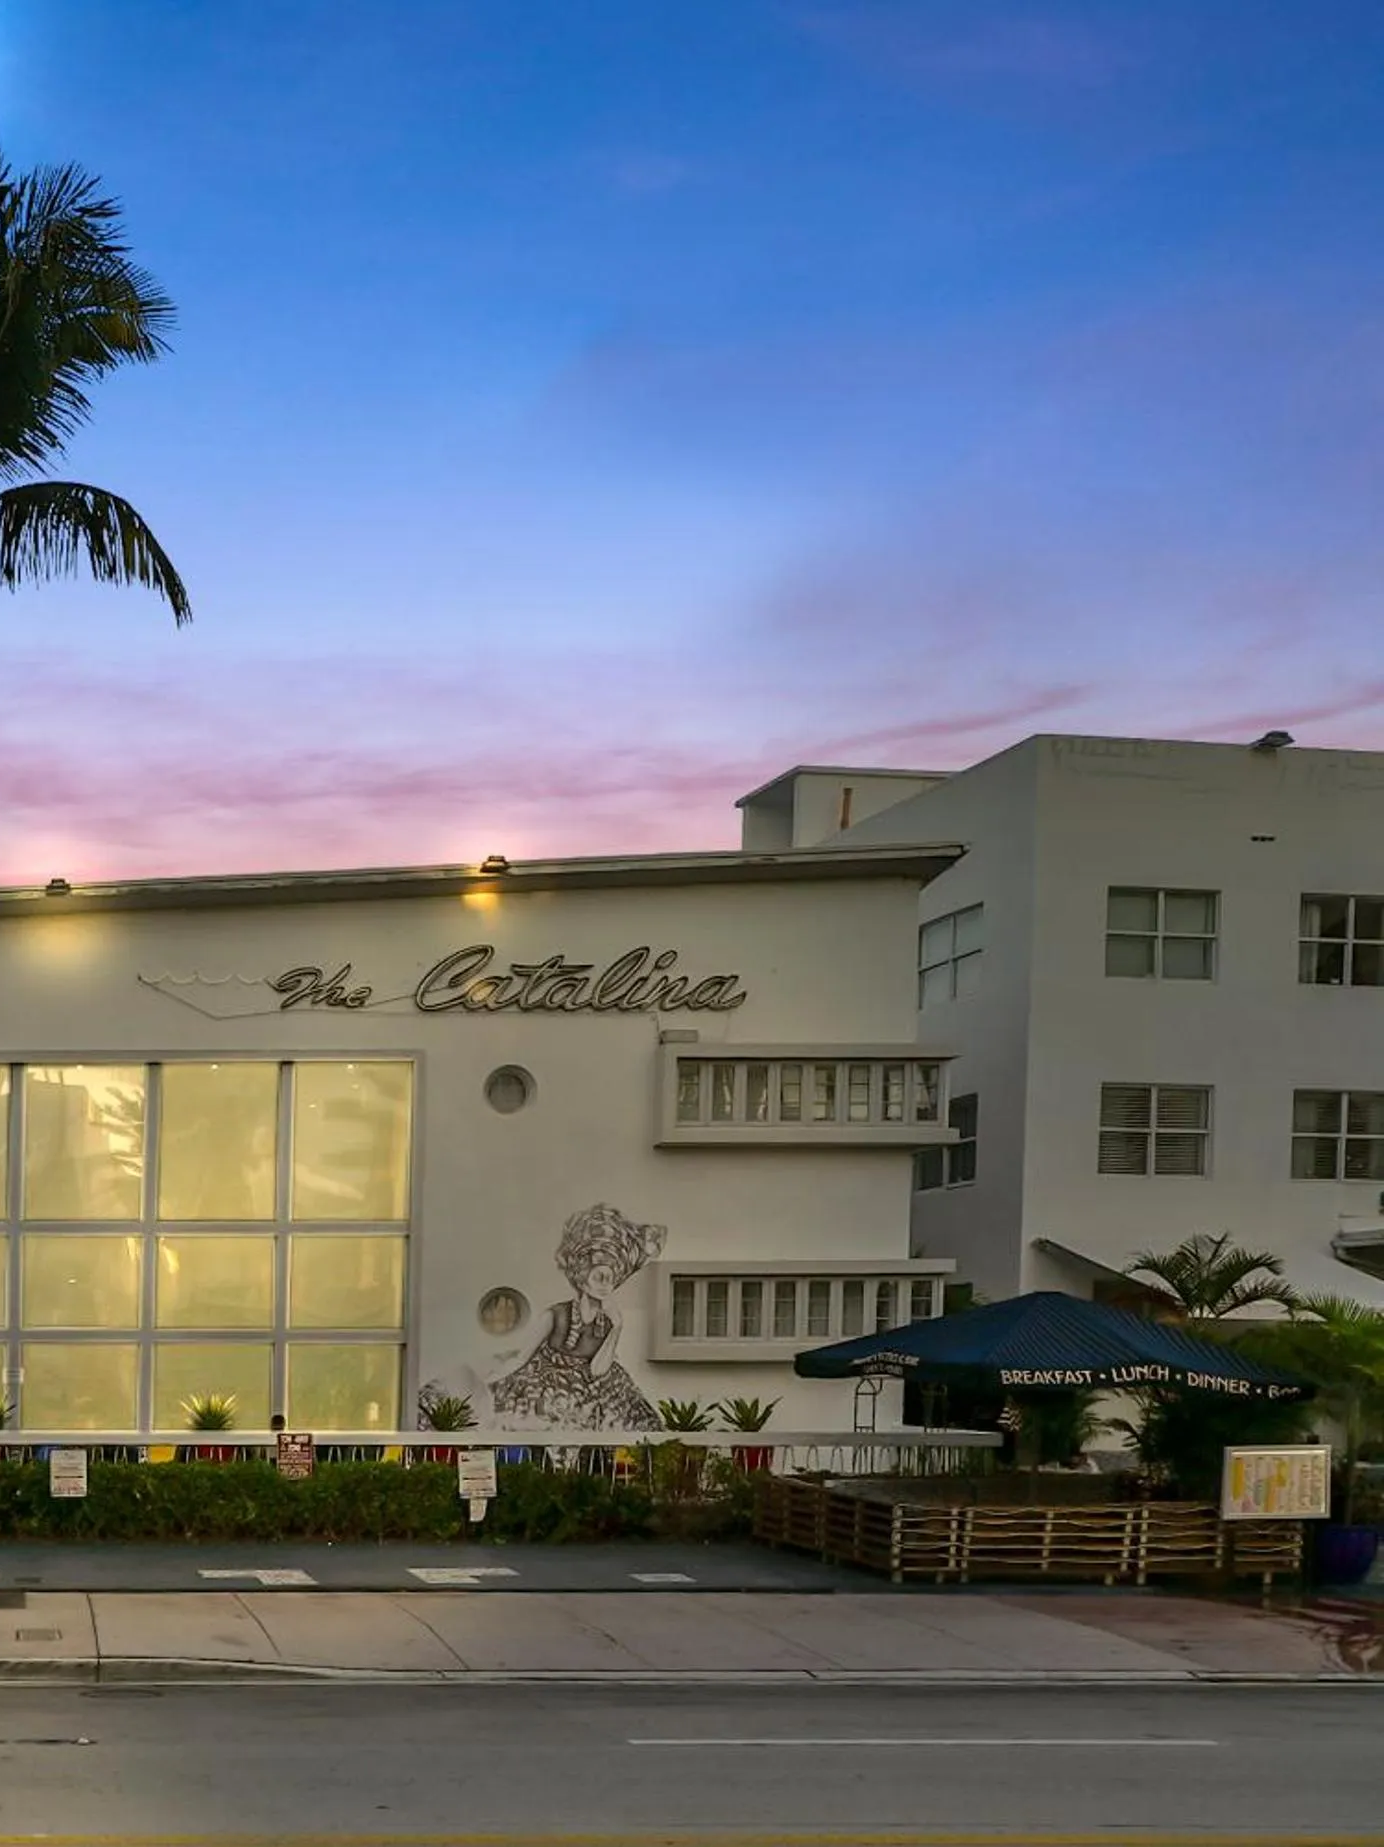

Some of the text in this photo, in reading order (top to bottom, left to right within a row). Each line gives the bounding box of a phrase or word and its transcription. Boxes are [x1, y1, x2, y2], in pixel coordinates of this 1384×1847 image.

[268, 944, 747, 1012] The Catalina
[1000, 1369, 1094, 1384] BREAKFAST
[1111, 1365, 1170, 1383] LUNCH
[1187, 1372, 1250, 1395] DINNER
